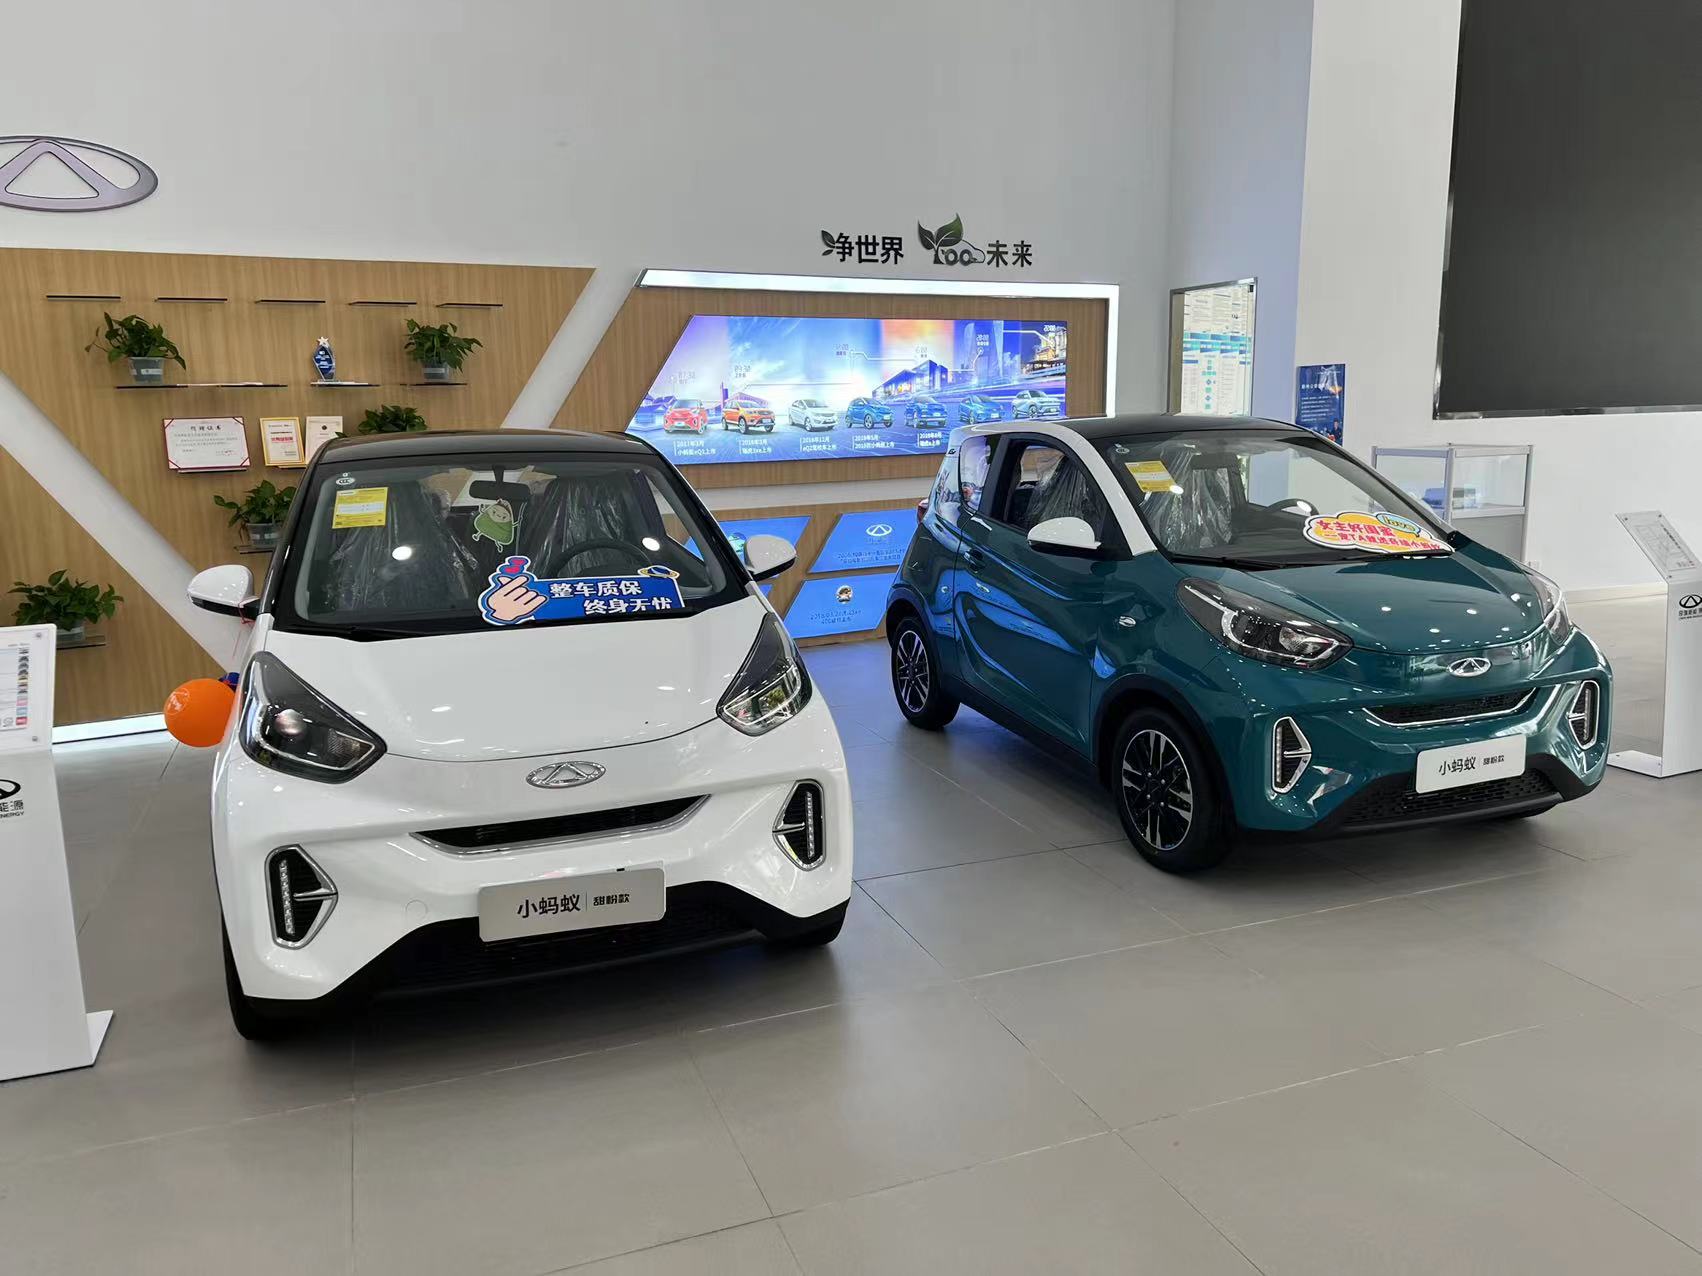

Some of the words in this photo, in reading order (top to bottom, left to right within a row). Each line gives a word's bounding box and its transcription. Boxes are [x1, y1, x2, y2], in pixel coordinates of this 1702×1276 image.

[821, 230, 904, 264] 净世界
[987, 240, 1033, 267] 未来
[550, 580, 643, 598] 整车质保
[584, 597, 673, 615] 终身无忧
[1439, 756, 1476, 775] 小蚂蚁
[517, 894, 581, 919] 小蚂蚁
[593, 893, 630, 906] 甜粉款
